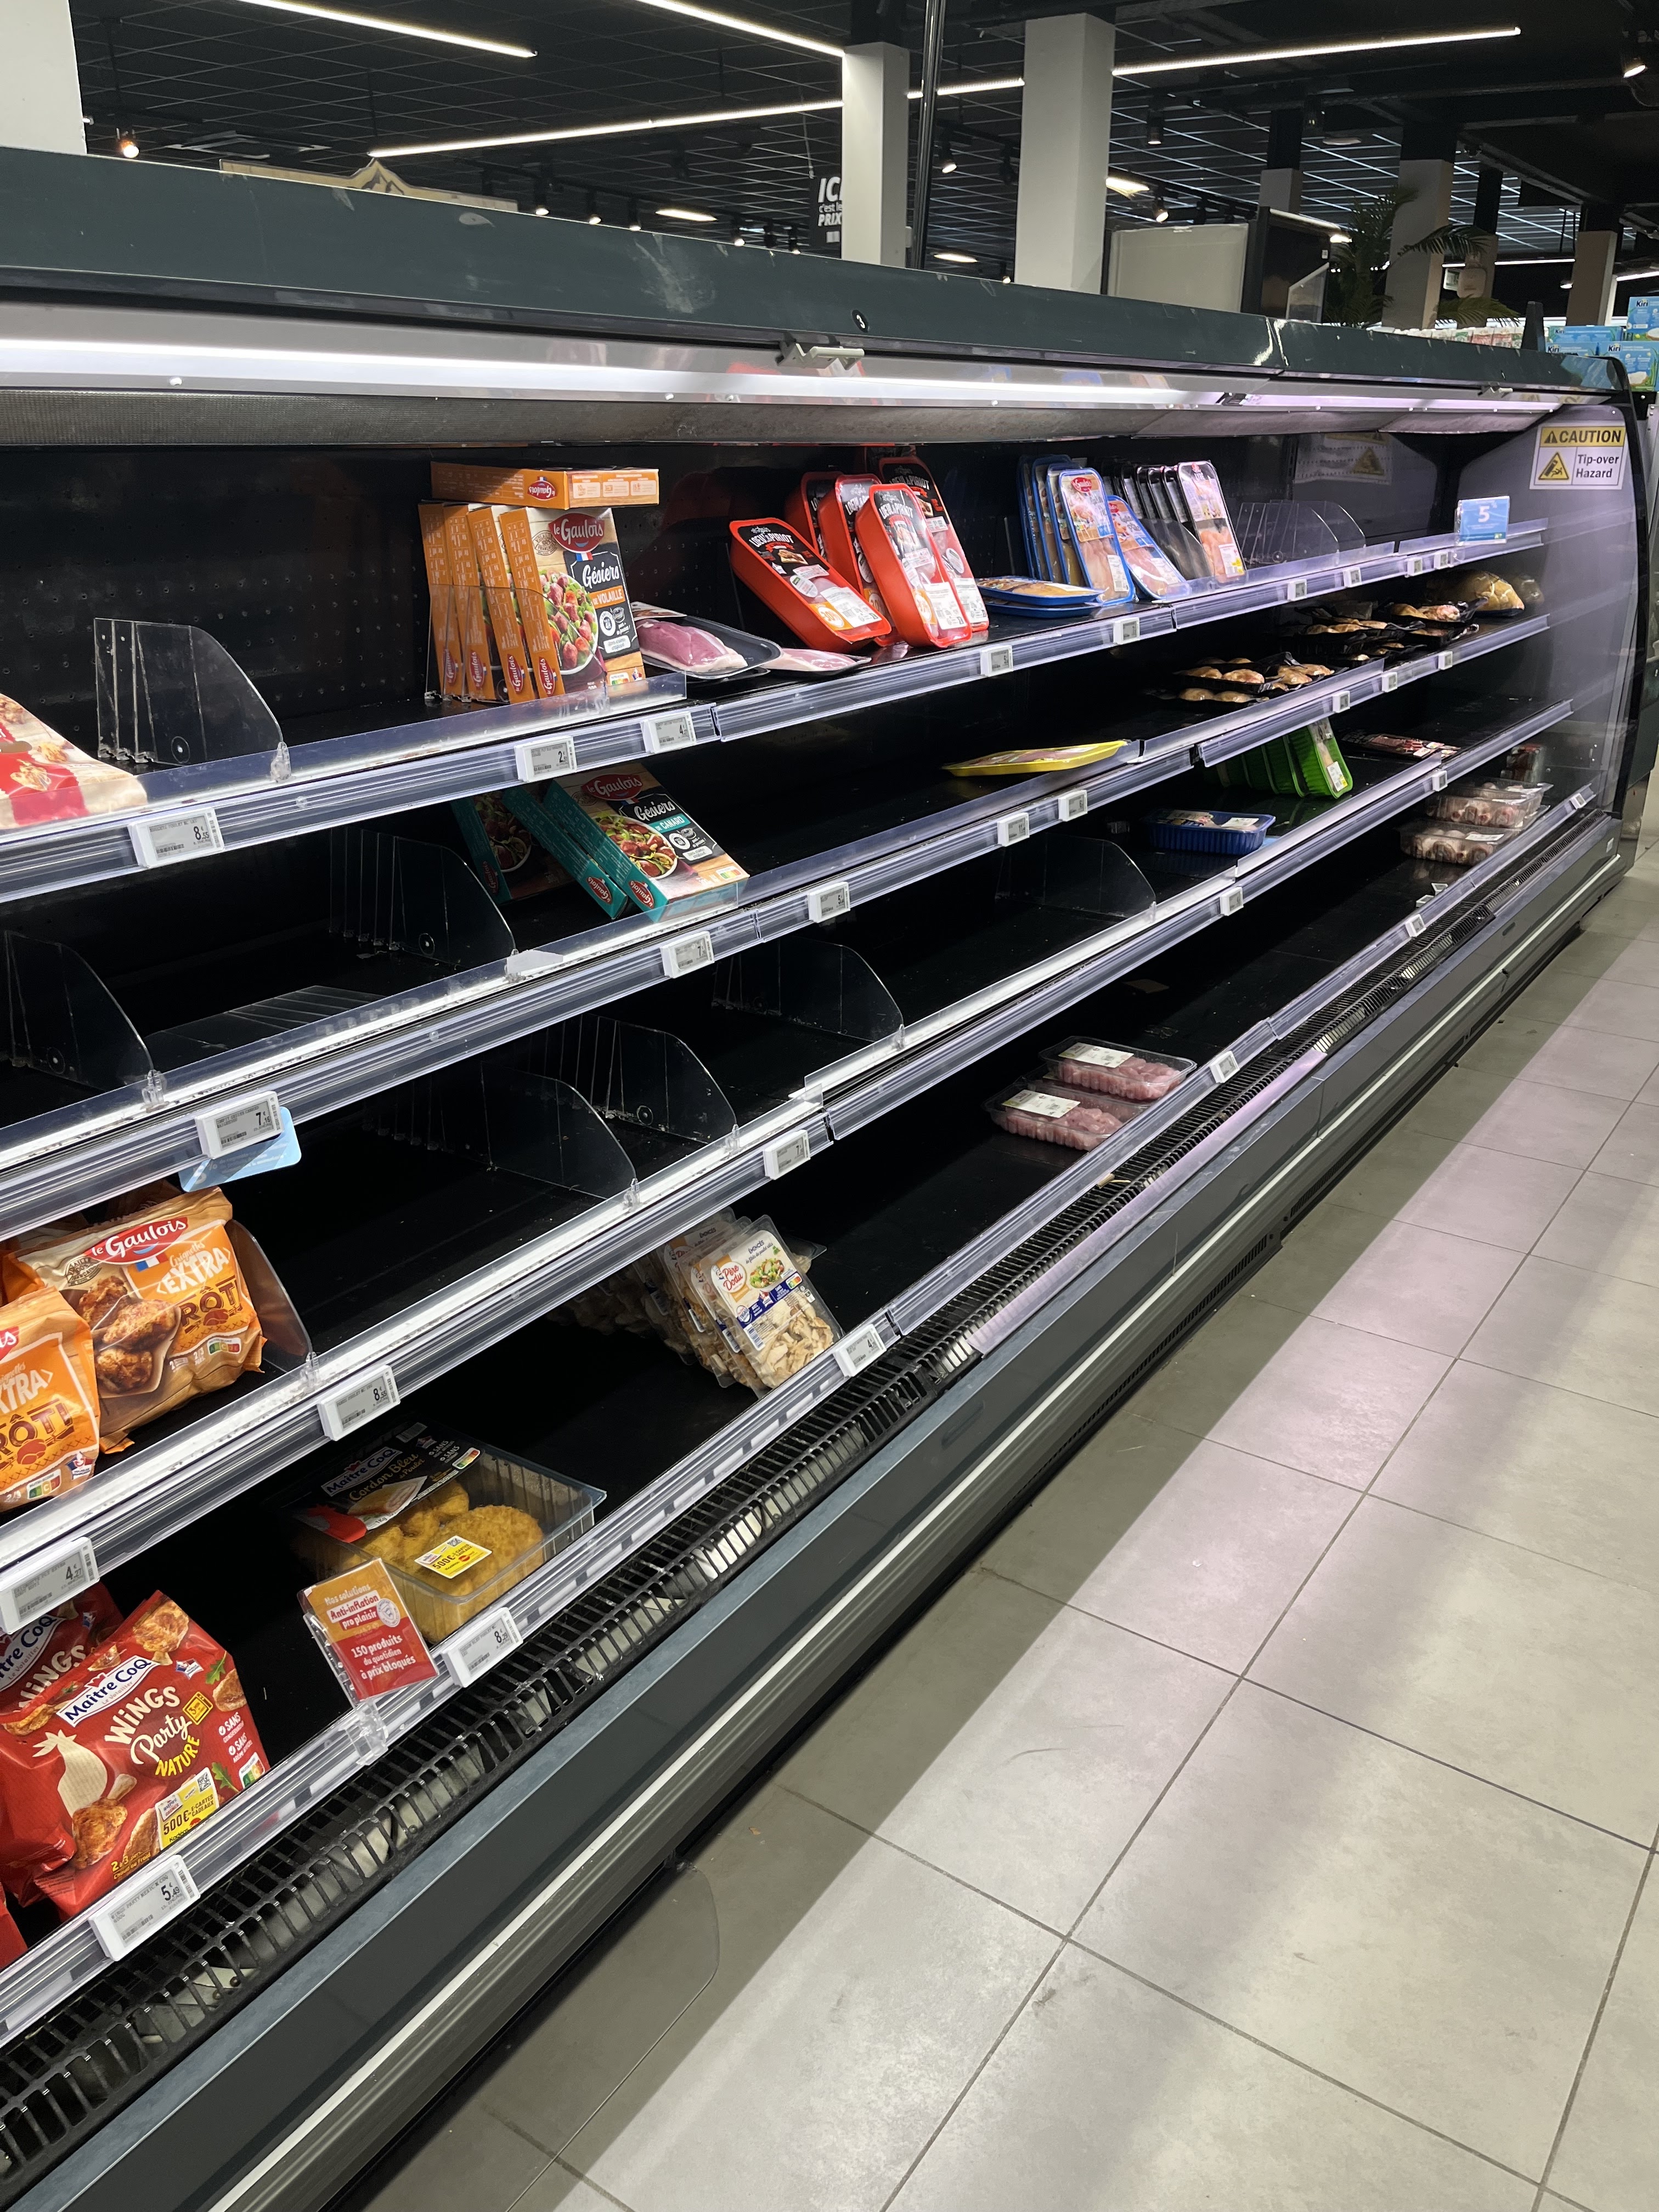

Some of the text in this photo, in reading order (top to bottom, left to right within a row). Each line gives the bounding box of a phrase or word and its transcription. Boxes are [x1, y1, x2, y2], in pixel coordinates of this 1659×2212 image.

[818, 177, 843, 203] IC
[818, 212, 842, 226] PRIX
[1559, 430, 1622, 443] CAUTION
[1577, 454, 1620, 466] Tip-over
[1576, 468, 1613, 478] Hazard
[554, 518, 604, 545] le Gaulois
[769, 533, 795, 544] PIRIOT
[583, 561, 620, 589] Gésiers
[597, 589, 624, 605] VOLAILLE
[508, 655, 521, 688] Gaulois
[540, 658, 554, 691] Gaulois
[558, 751, 563, 763] 2
[586, 777, 642, 796] le Gaulois
[634, 800, 676, 821] Gésiers
[194, 826, 201, 840] 8
[659, 816, 685, 830] CANARD
[588, 877, 610, 901] Gaulois
[630, 880, 651, 905] Gaulois
[256, 1111, 261, 1125] 7
[92, 1220, 187, 1258] le Gaulois
[163, 1248, 230, 1294] EXTRA
[723, 1265, 740, 1280] Père
[723, 1273, 743, 1291] Dodu
[179, 1279, 241, 1327] RÔT
[0, 1370, 49, 1414] XTRA
[374, 1388, 380, 1401] 8
[326, 1449, 398, 1494] Maître CoQ
[349, 1453, 419, 1502] Cordon Bleu
[66, 1566, 74, 1580] 4
[338, 1583, 371, 1601] solutions
[330, 1594, 379, 1620] Anti-inflation
[342, 1609, 377, 1630] pro plaisir
[21, 1616, 58, 1648] CoQ
[494, 1630, 502, 1644] 8
[351, 1634, 403, 1658] 150 produits
[359, 1654, 416, 1680] à prix bloqués
[363, 1648, 402, 1666] du quotidien
[19, 1645, 87, 1708] iNGS
[65, 1658, 152, 1721] Maître CoQ
[225, 1712, 241, 1731] SANS
[130, 1714, 193, 1764] Party
[234, 1732, 247, 1751] SANS
[155, 1735, 200, 1777] NATURE
[191, 1800, 214, 1817] CADEAUX
[163, 1810, 189, 1835] 500€
[111, 1861, 119, 1872] 2
[123, 1855, 129, 1865] 3
[138, 1852, 151, 1864] Froid
[161, 1884, 171, 1901] 5
